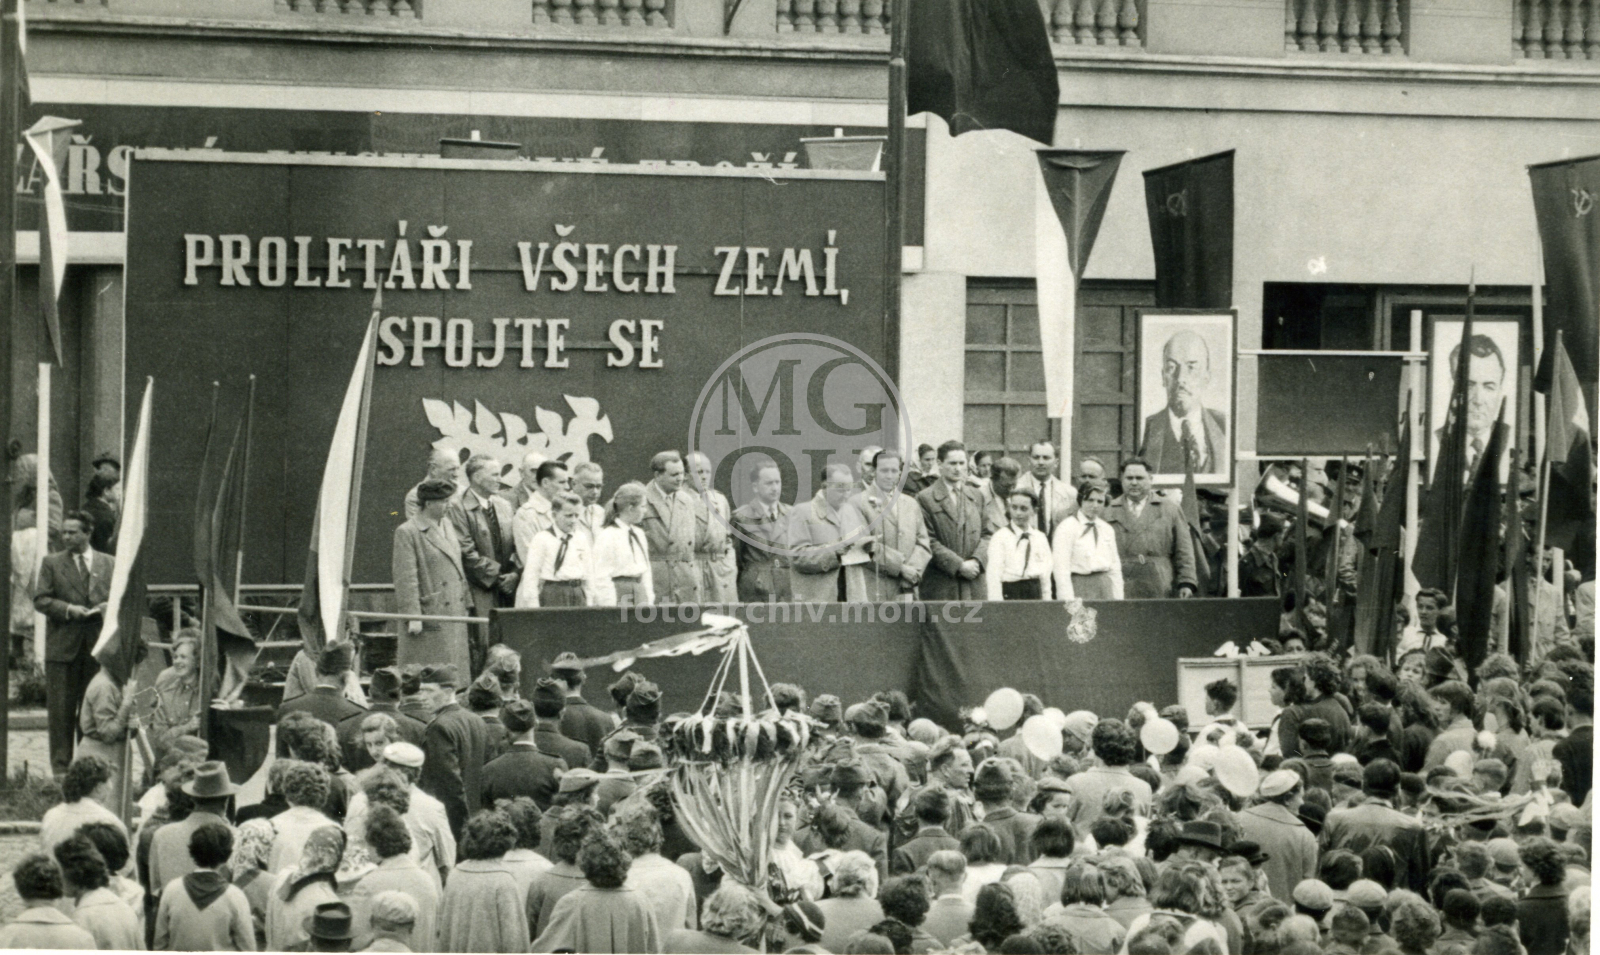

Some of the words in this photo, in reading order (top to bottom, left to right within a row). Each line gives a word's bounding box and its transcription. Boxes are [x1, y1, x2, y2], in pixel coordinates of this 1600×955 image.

[183, 220, 473, 290] PROLETÁŘI
[515, 224, 678, 293] VŠECH
[714, 229, 849, 305] ZEMÍ,
[377, 316, 570, 368] SPOJTE
[607, 319, 664, 368] SE
